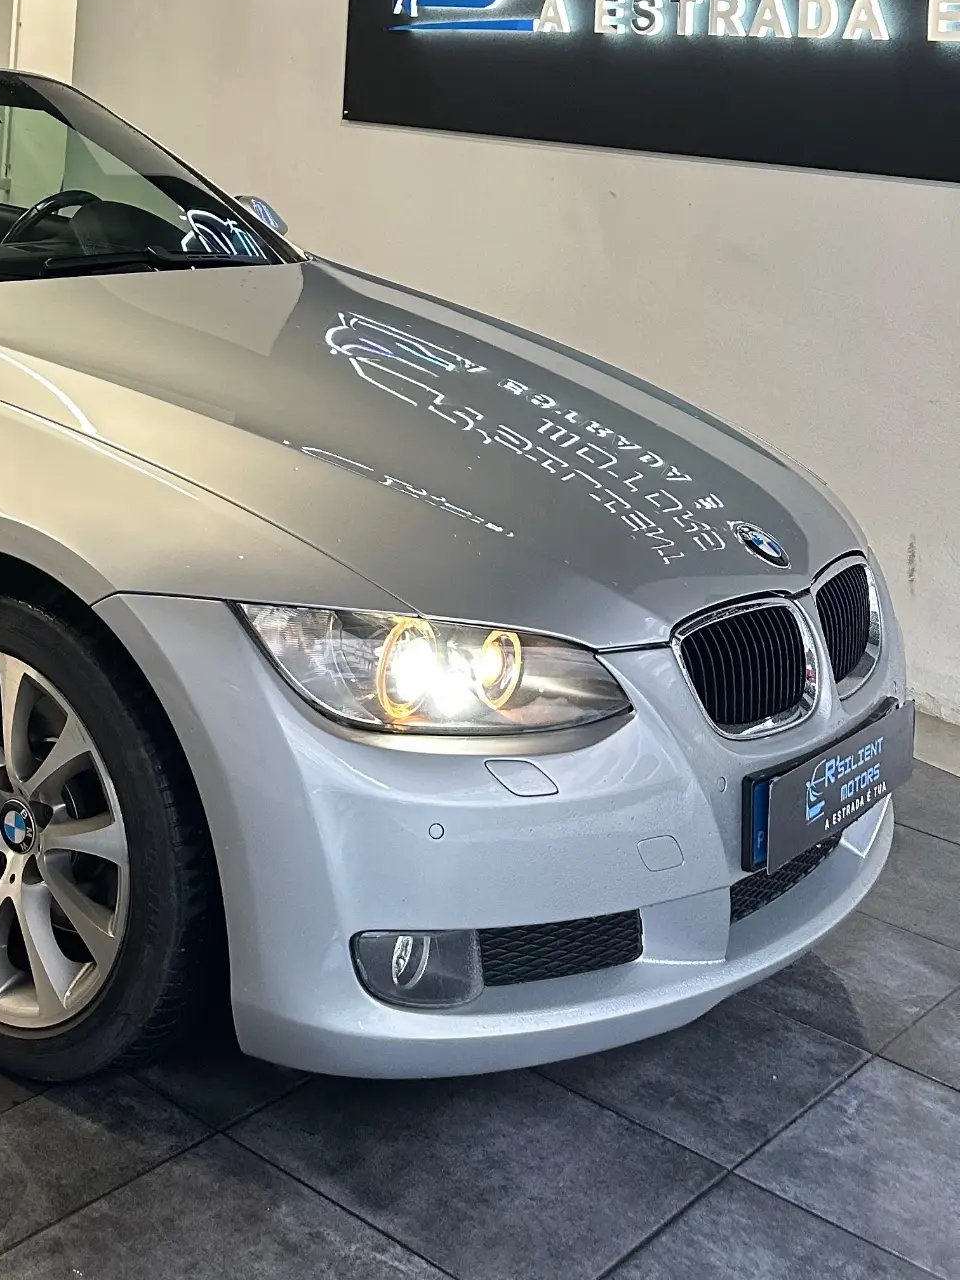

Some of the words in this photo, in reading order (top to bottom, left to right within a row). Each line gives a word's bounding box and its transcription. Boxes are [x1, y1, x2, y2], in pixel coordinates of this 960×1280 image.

[840, 762, 881, 802] MOTORS
[824, 818, 830, 830] A
[832, 796, 865, 825] ESTRADA
[873, 781, 887, 797] TUA
